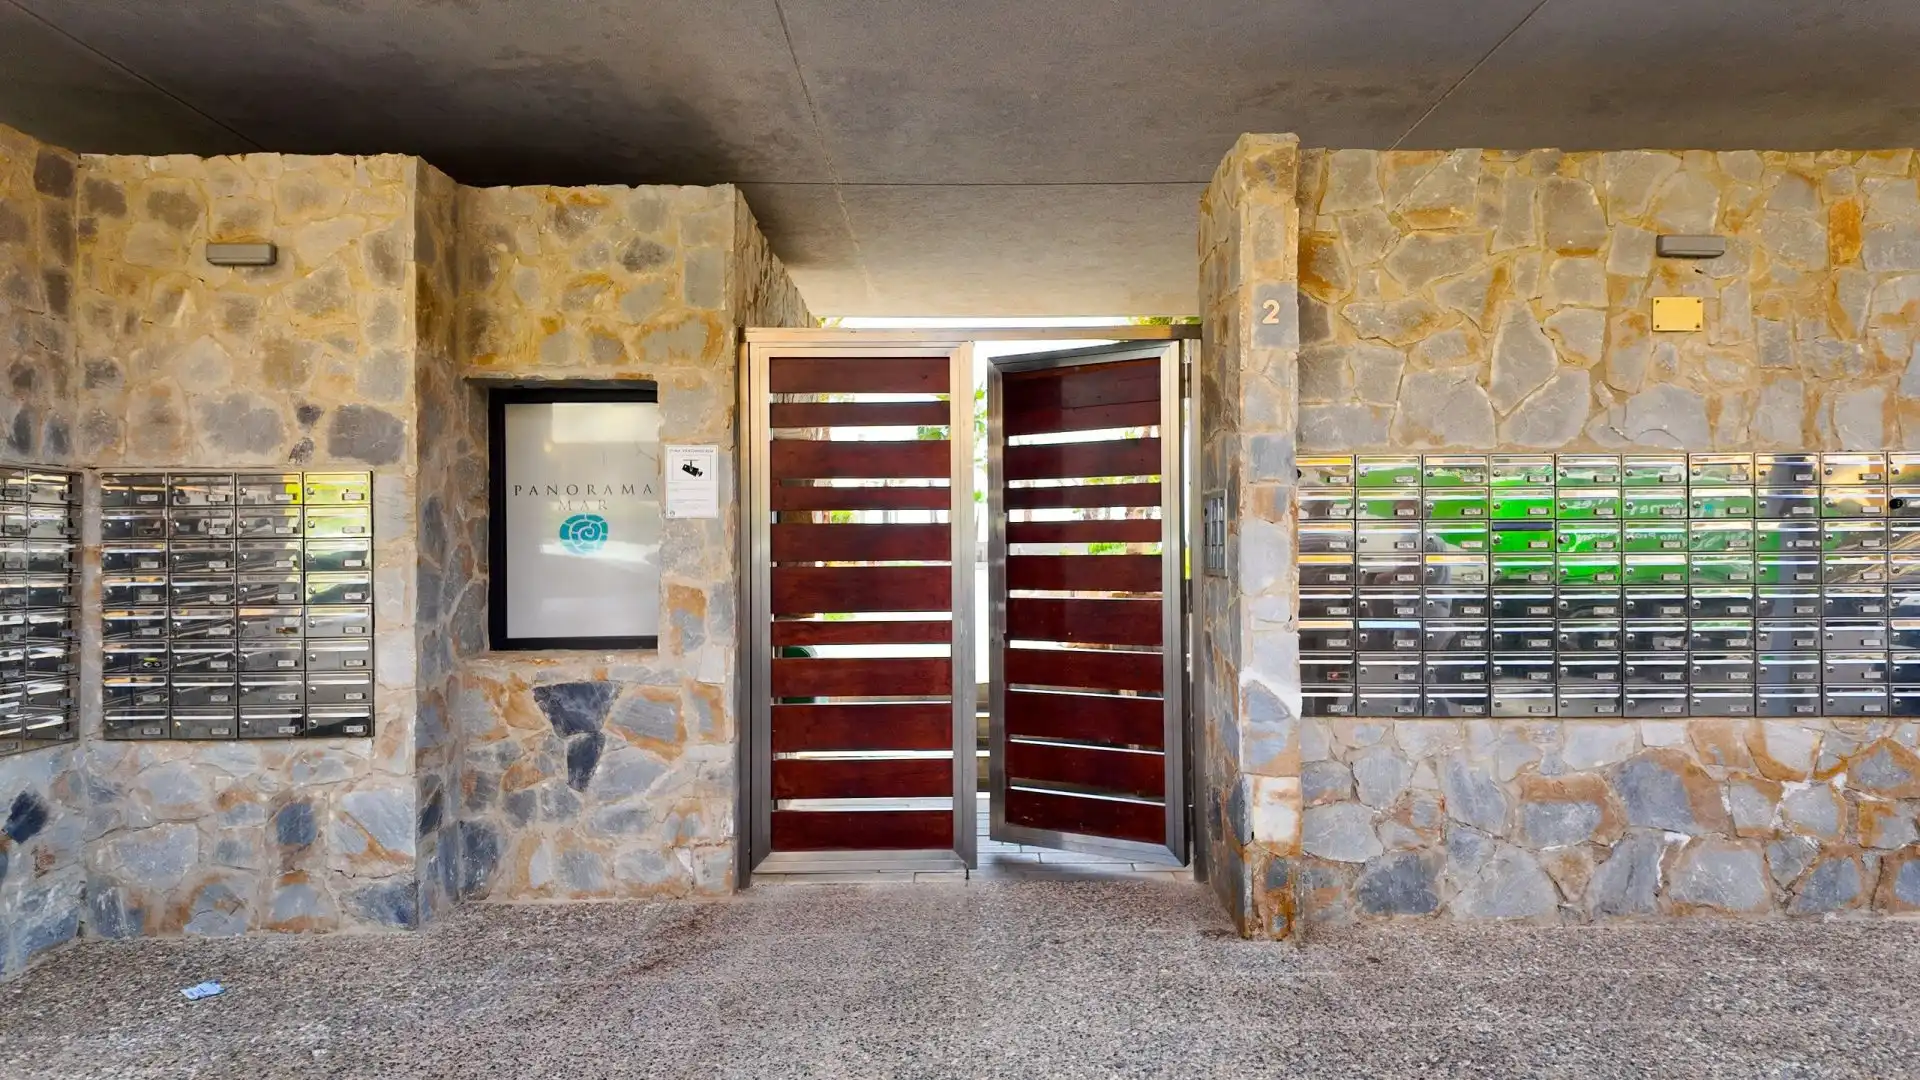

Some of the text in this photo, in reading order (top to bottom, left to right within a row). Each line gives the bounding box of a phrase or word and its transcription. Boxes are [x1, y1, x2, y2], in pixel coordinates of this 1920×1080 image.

[1262, 299, 1280, 324] 2
[514, 484, 652, 496] PANORAMA
[558, 499, 608, 511] MAR
